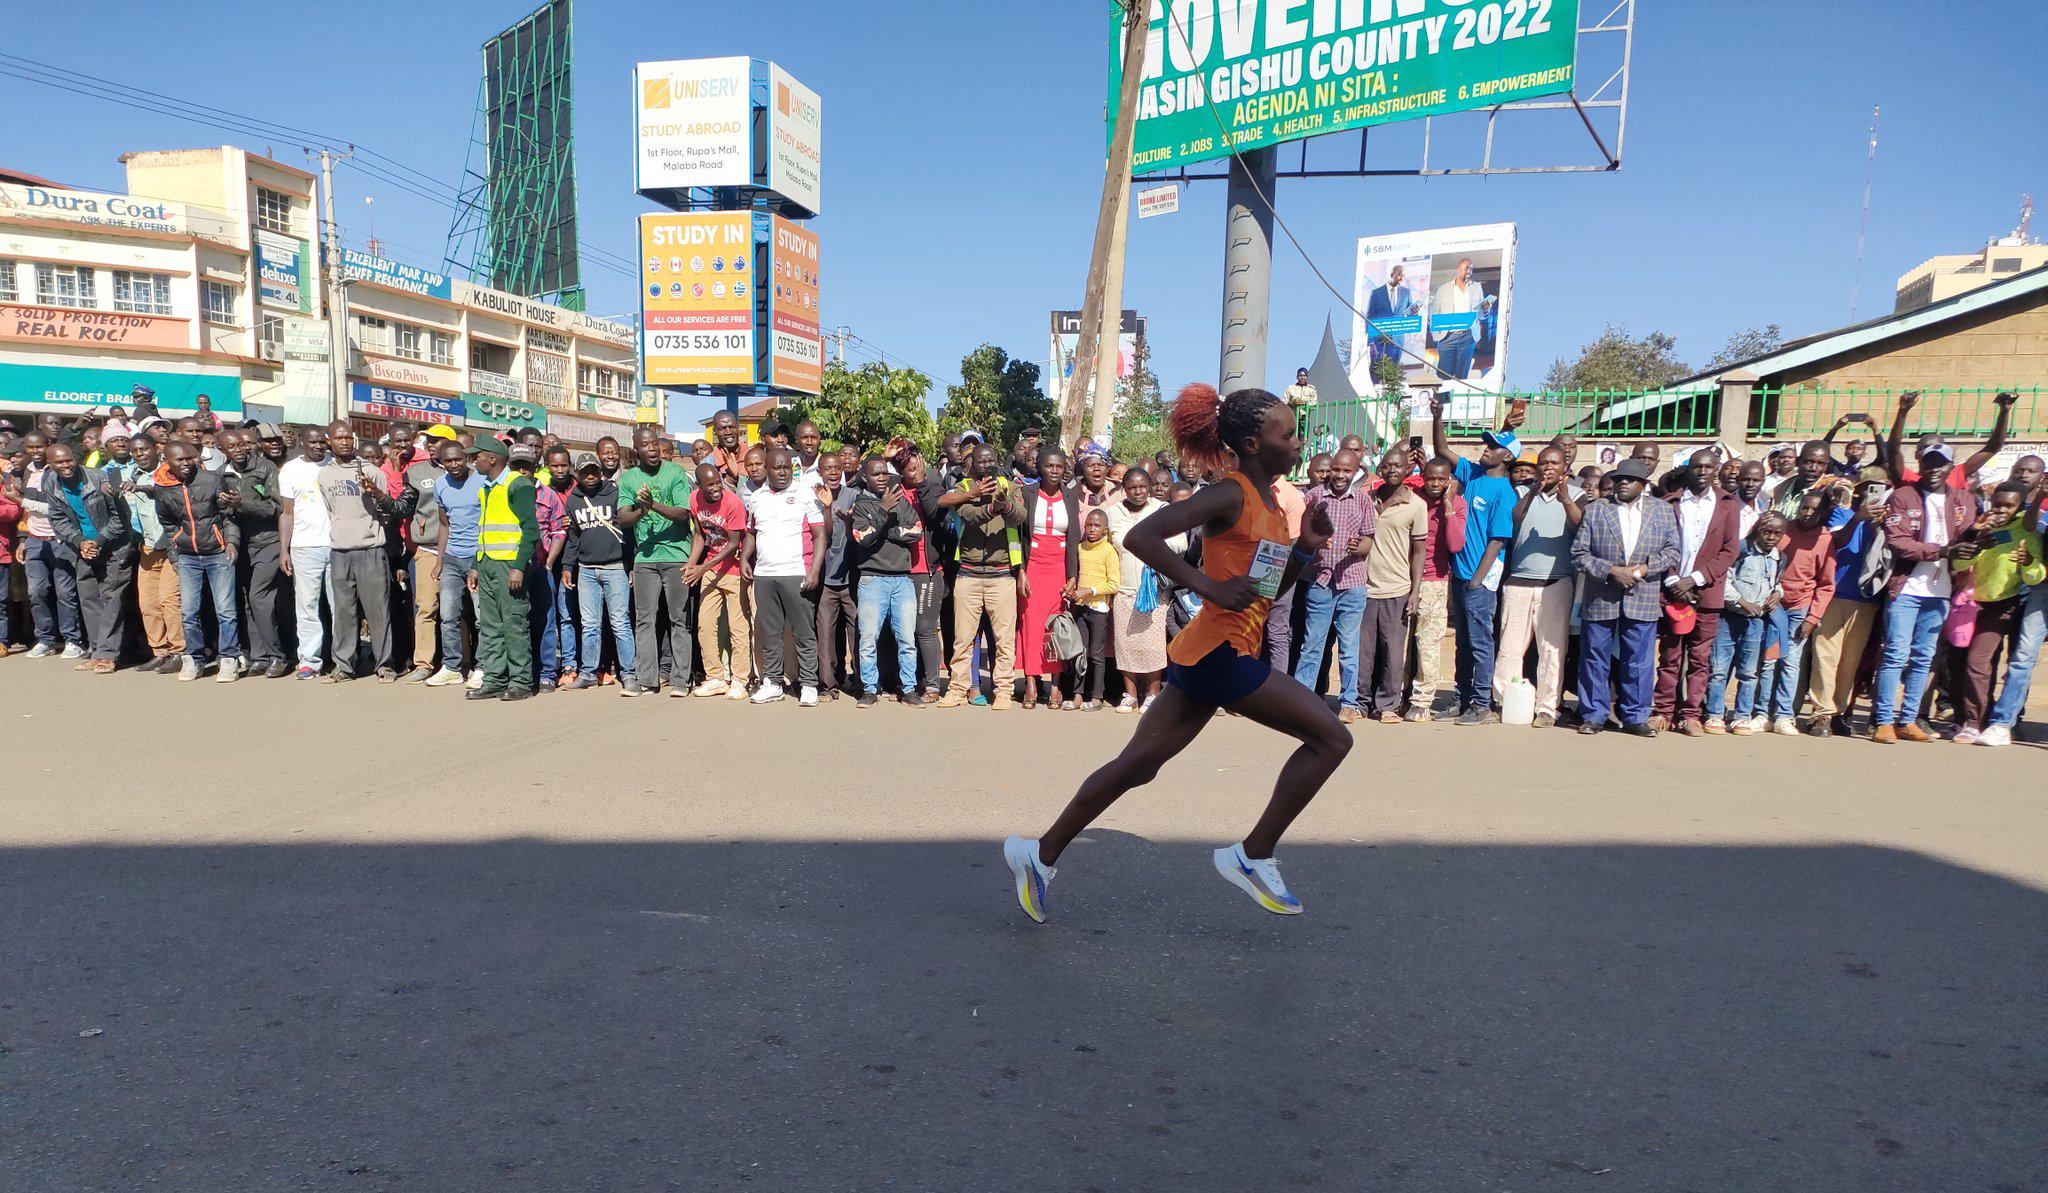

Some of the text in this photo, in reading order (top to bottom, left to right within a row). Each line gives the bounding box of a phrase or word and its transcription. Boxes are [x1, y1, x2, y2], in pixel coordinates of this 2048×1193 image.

[1134, 0, 1552, 121] ASIN GISHU COUNTY 2022
[675, 78, 740, 99] UNISERV
[1233, 87, 1308, 126] AGENDA
[1315, 80, 1335, 108] NI
[1342, 71, 1386, 103] SITA
[790, 94, 820, 128] UNISERV
[1133, 146, 1172, 166] CULTURE
[1346, 89, 1446, 122] INFRASTRUCTURE
[1472, 65, 1571, 98] EMPOWERMENT
[641, 121, 741, 137] STUDY ABROAD
[648, 145, 739, 158] 1st Floor, Rupa's Mall,
[776, 127, 820, 163] STUDY ABROAD
[700, 160, 722, 170] Road
[26, 188, 168, 220] Dura Coat
[1156, 192, 1176, 203] LIMITED
[80, 216, 176, 232] ASK THE EXPERTS
[652, 224, 744, 245] STUDY IN
[778, 227, 818, 262] STUDY IN
[1373, 244, 1392, 254] SBM
[260, 264, 297, 286] deluxe
[345, 248, 444, 288] EXCELLENT MAR AND
[374, 271, 430, 296] RESISTANCE
[286, 292, 298, 304] 4L
[474, 290, 556, 325] KABULIOT HOUSE
[15, 308, 56, 321] SOLID
[63, 312, 152, 328] PROTECTION
[585, 315, 629, 338] Dura Coat
[16, 320, 128, 342] REAL ROC!
[544, 332, 567, 346] DENTAL
[654, 335, 746, 349] 0735 536 101
[778, 336, 818, 360] 0735 536 101
[44, 390, 158, 405] ELDORET BRAH
[371, 388, 451, 410] Biocyte
[366, 403, 454, 425] CHEMIST
[479, 401, 534, 420] oppo
